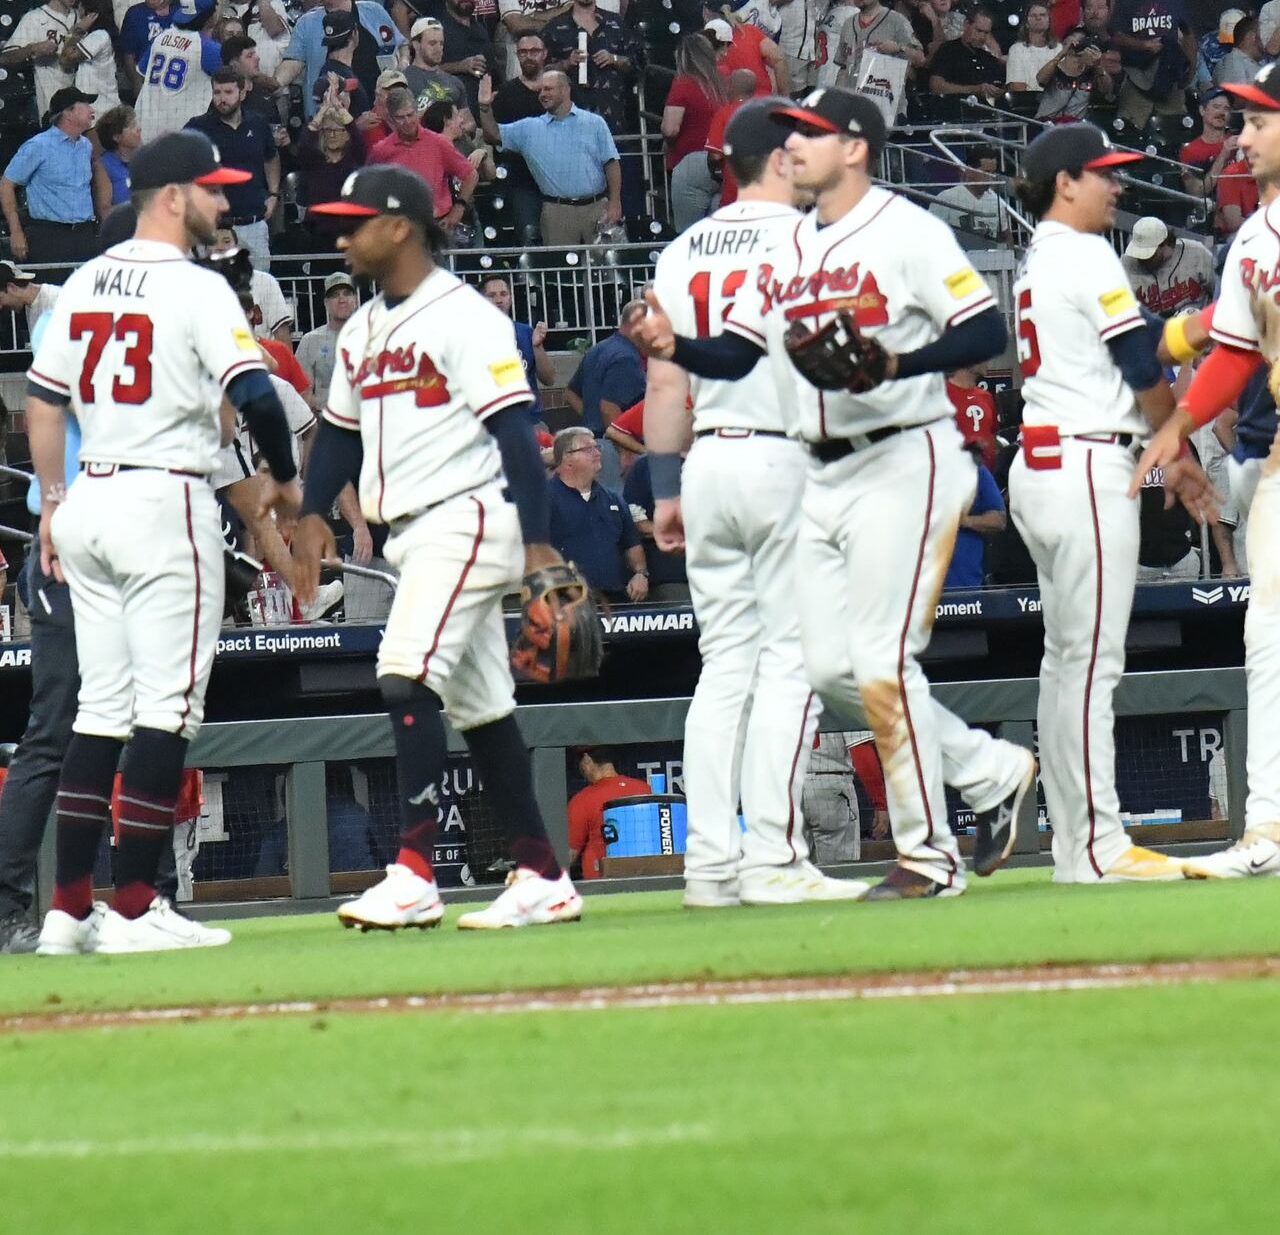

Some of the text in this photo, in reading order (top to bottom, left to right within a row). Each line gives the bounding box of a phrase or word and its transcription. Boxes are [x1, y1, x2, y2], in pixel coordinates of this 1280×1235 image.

[1131, 15, 1173, 32] BRAVES
[161, 34, 193, 52] OLSON
[147, 52, 188, 92] 28
[688, 228, 770, 261] MURPH
[92, 269, 147, 299] WALL
[758, 262, 860, 317] Braves
[69, 312, 154, 406] 73
[600, 613, 694, 634] YANMAR
[934, 600, 982, 621] pment
[215, 632, 341, 655] pact Equipment
[660, 808, 673, 855] POWER
[446, 849, 459, 861] OF
